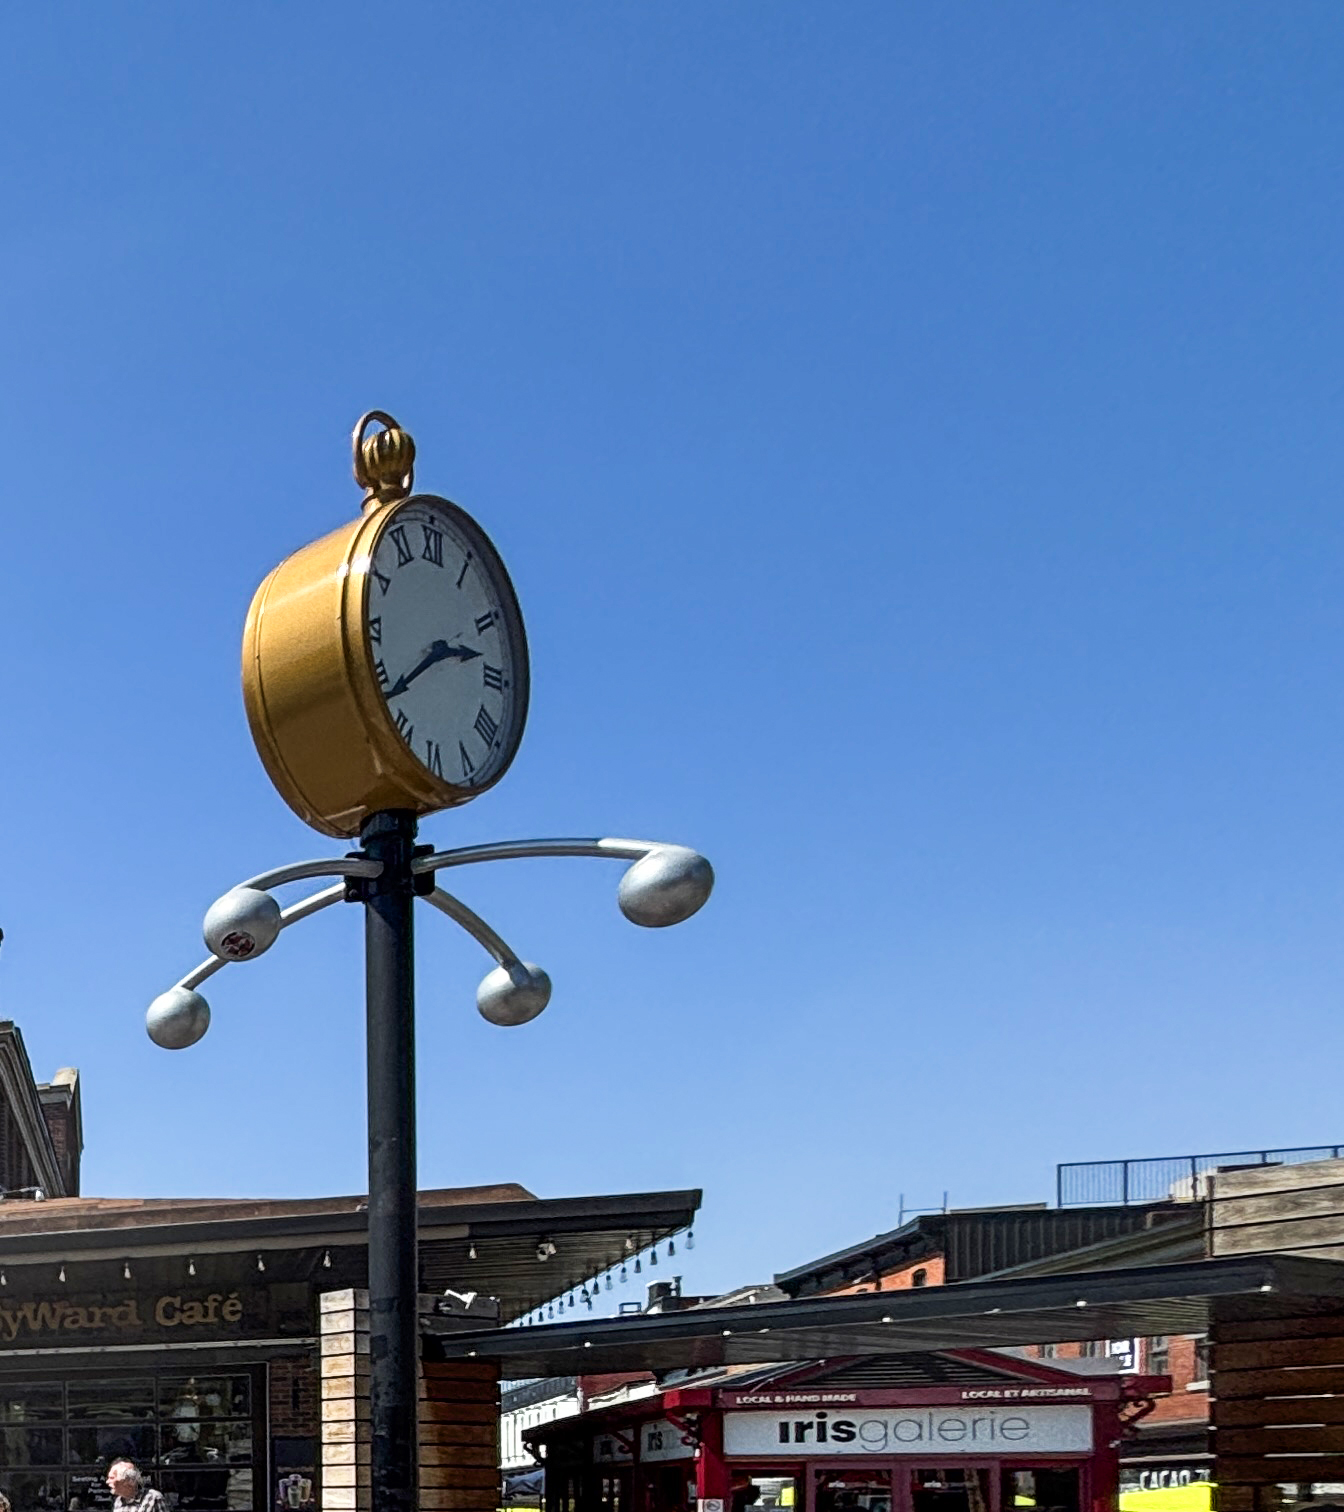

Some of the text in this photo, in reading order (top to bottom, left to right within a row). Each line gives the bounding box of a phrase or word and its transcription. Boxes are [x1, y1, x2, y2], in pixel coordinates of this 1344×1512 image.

[389, 524, 414, 568] XI
[422, 525, 444, 568] XII
[483, 663, 504, 692] III
[155, 1292, 244, 1327] Café
